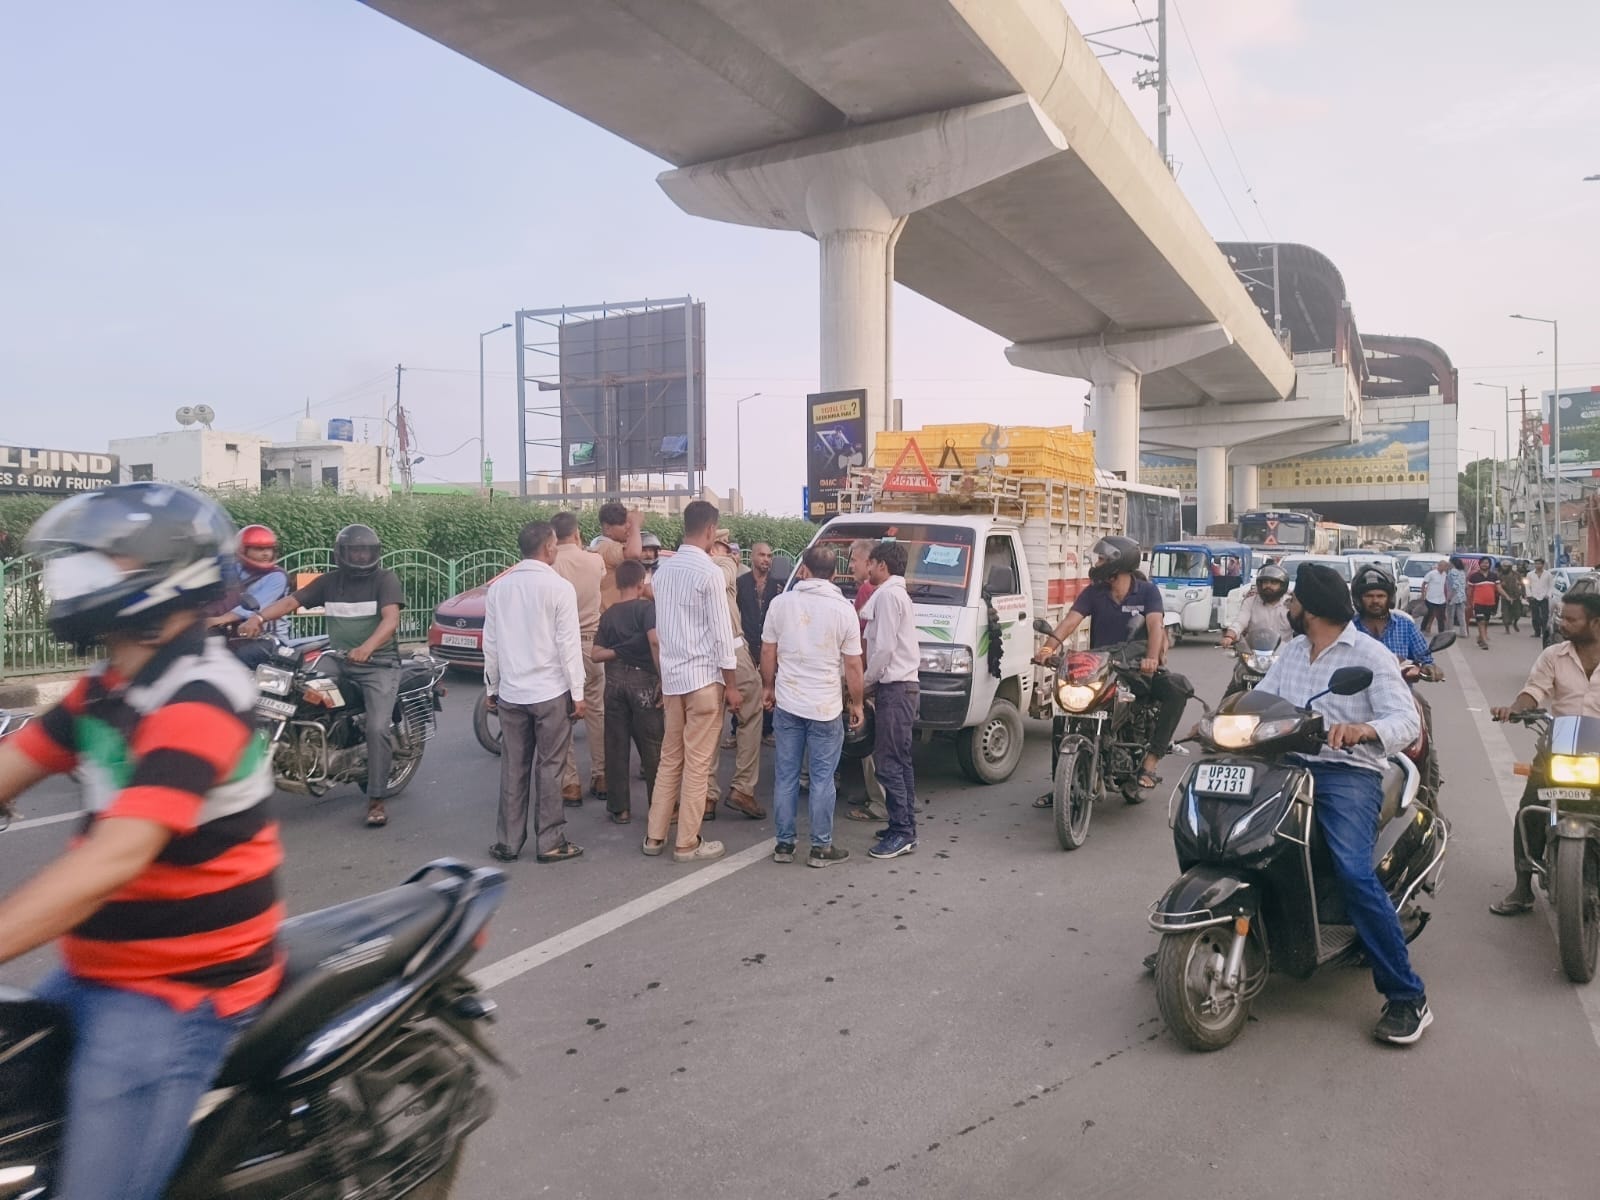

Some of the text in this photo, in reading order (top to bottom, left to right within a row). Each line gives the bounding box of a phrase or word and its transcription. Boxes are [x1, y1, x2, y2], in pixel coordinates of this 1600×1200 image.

[17, 473, 29, 486] &
[33, 474, 62, 488] DRY
[1207, 779, 1244, 793] X7131
